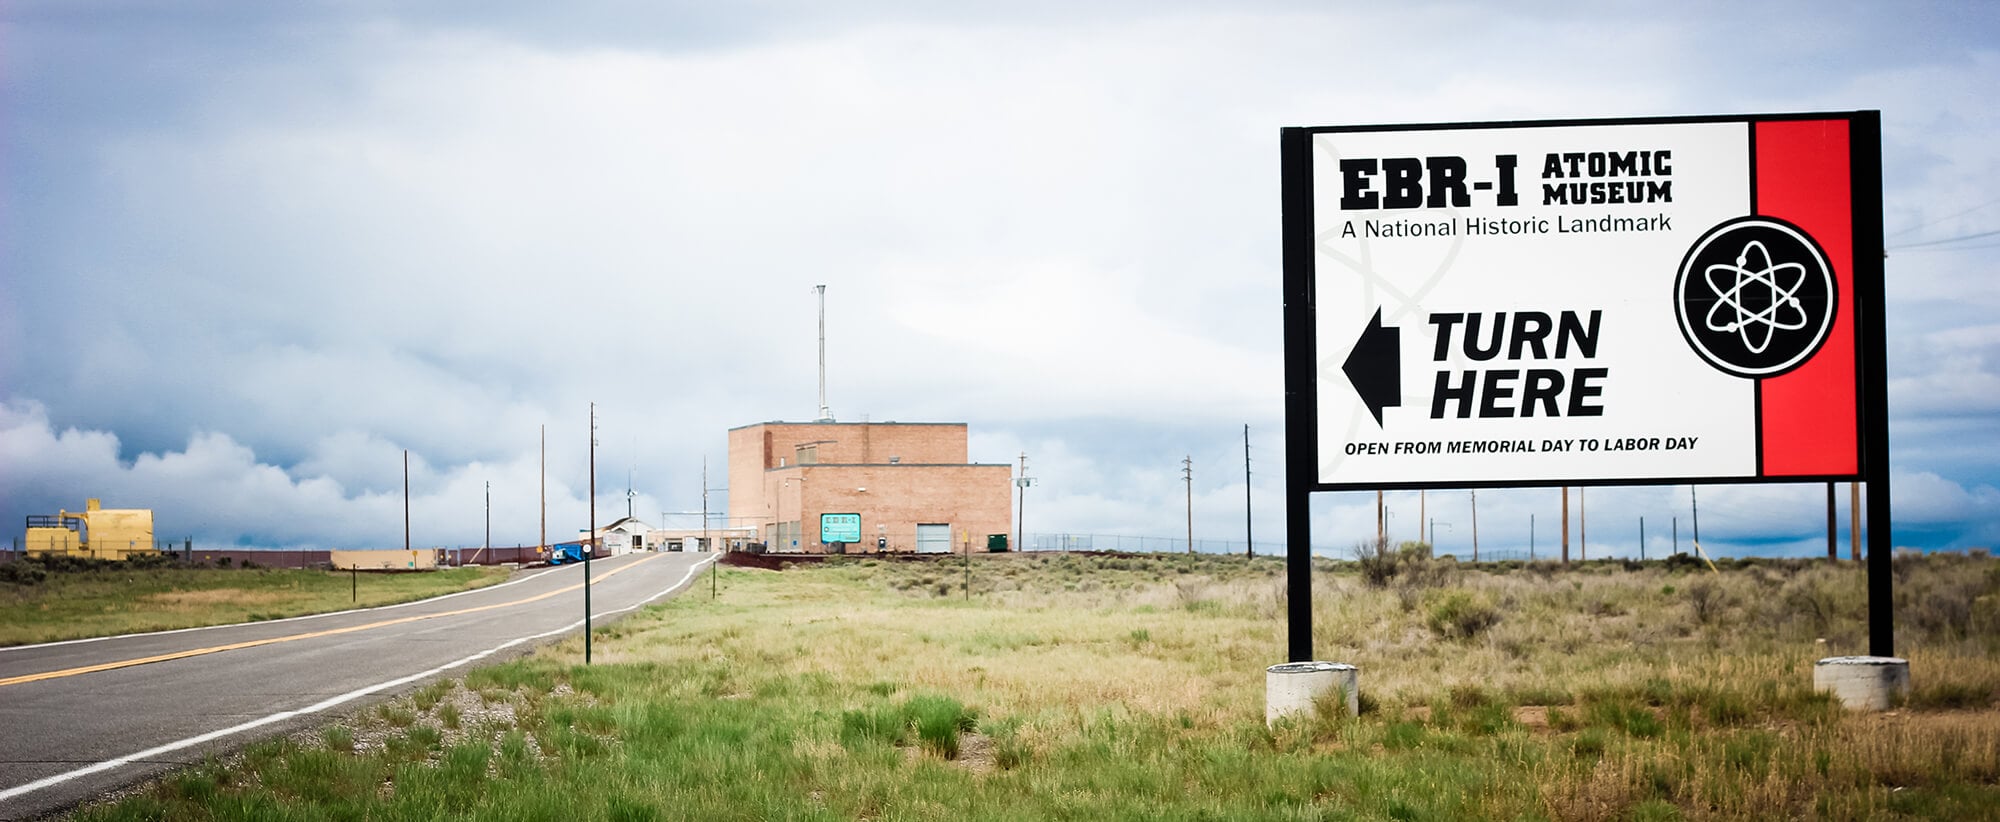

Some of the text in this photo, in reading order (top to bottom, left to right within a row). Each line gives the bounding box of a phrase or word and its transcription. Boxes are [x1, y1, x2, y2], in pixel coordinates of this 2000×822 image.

[1541, 149, 1673, 179] ATOMIC
[1339, 154, 1519, 211] EBR-I
[1542, 180, 1673, 206] MUSEUM
[1341, 212, 1672, 239] A National Historic Landmark
[1428, 309, 1603, 362] TURN
[1429, 367, 1609, 420] HERE
[1344, 436, 1699, 456] OPEN FROM MEMORIAL DAY TO LABOR DAY
